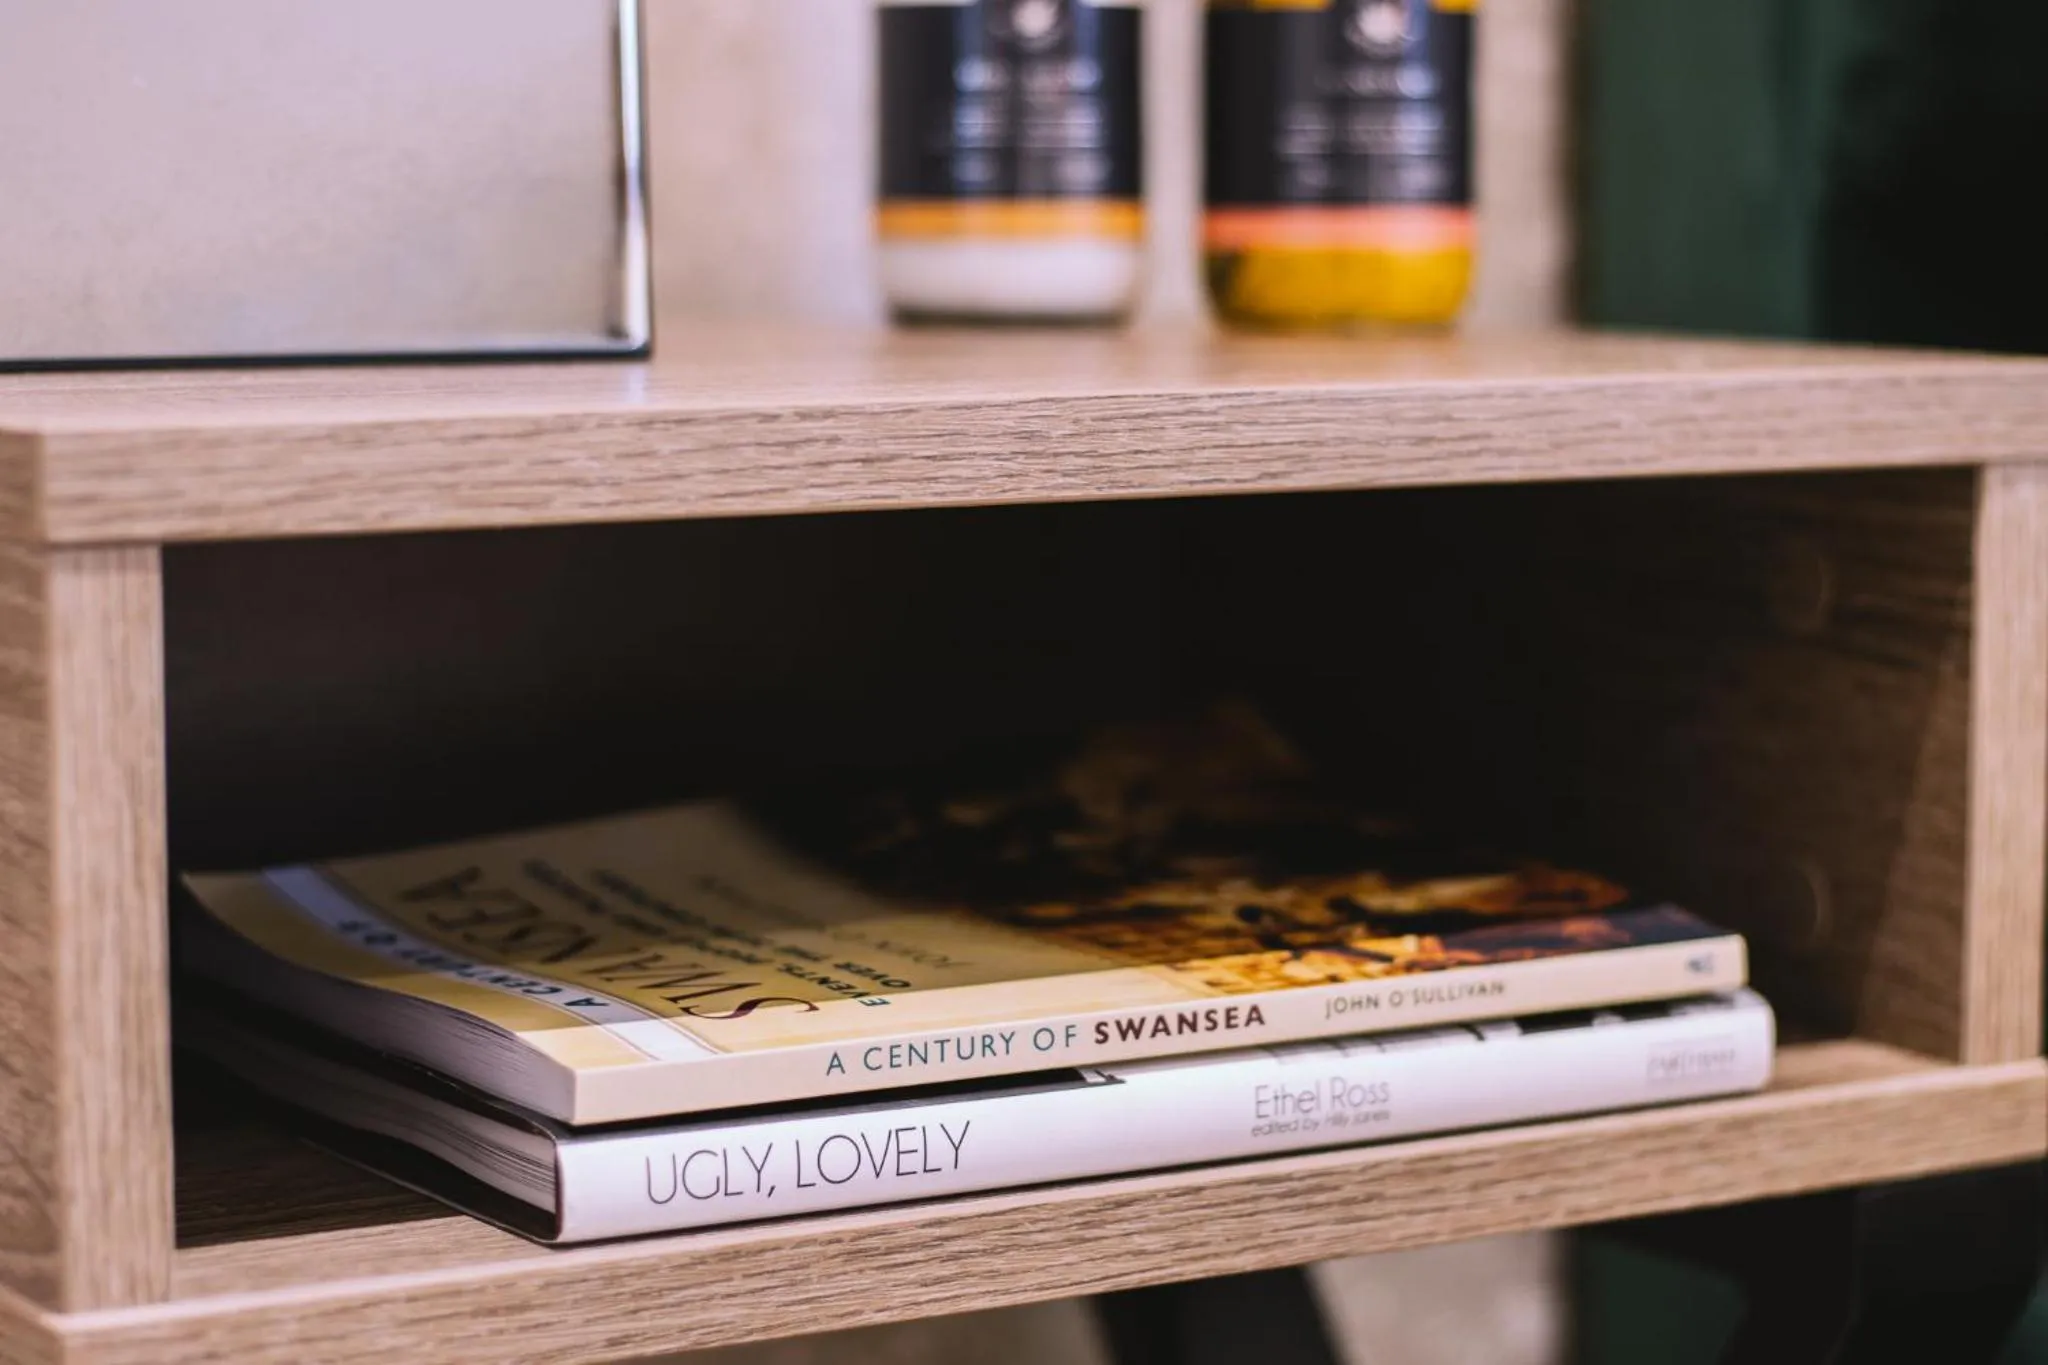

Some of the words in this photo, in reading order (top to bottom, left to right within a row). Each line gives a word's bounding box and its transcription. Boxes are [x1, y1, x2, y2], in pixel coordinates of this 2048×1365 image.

[398, 866, 820, 1020] SWANSEA
[563, 996, 610, 1008] A
[1325, 994, 1380, 1019] JOHN
[1389, 981, 1505, 1008] O'SULLIVAN
[826, 1051, 846, 1077] A
[863, 1031, 1016, 1072] CENTURY
[1033, 1024, 1078, 1052] OF
[1094, 1004, 1266, 1045] SWANSEA
[1255, 1079, 1321, 1119] Ethel
[1330, 1075, 1390, 1108] Ross
[1251, 1119, 1299, 1137] edited
[1302, 1117, 1320, 1132] by
[646, 1142, 776, 1205] UGLY,
[796, 1120, 970, 1188] LOVELY
